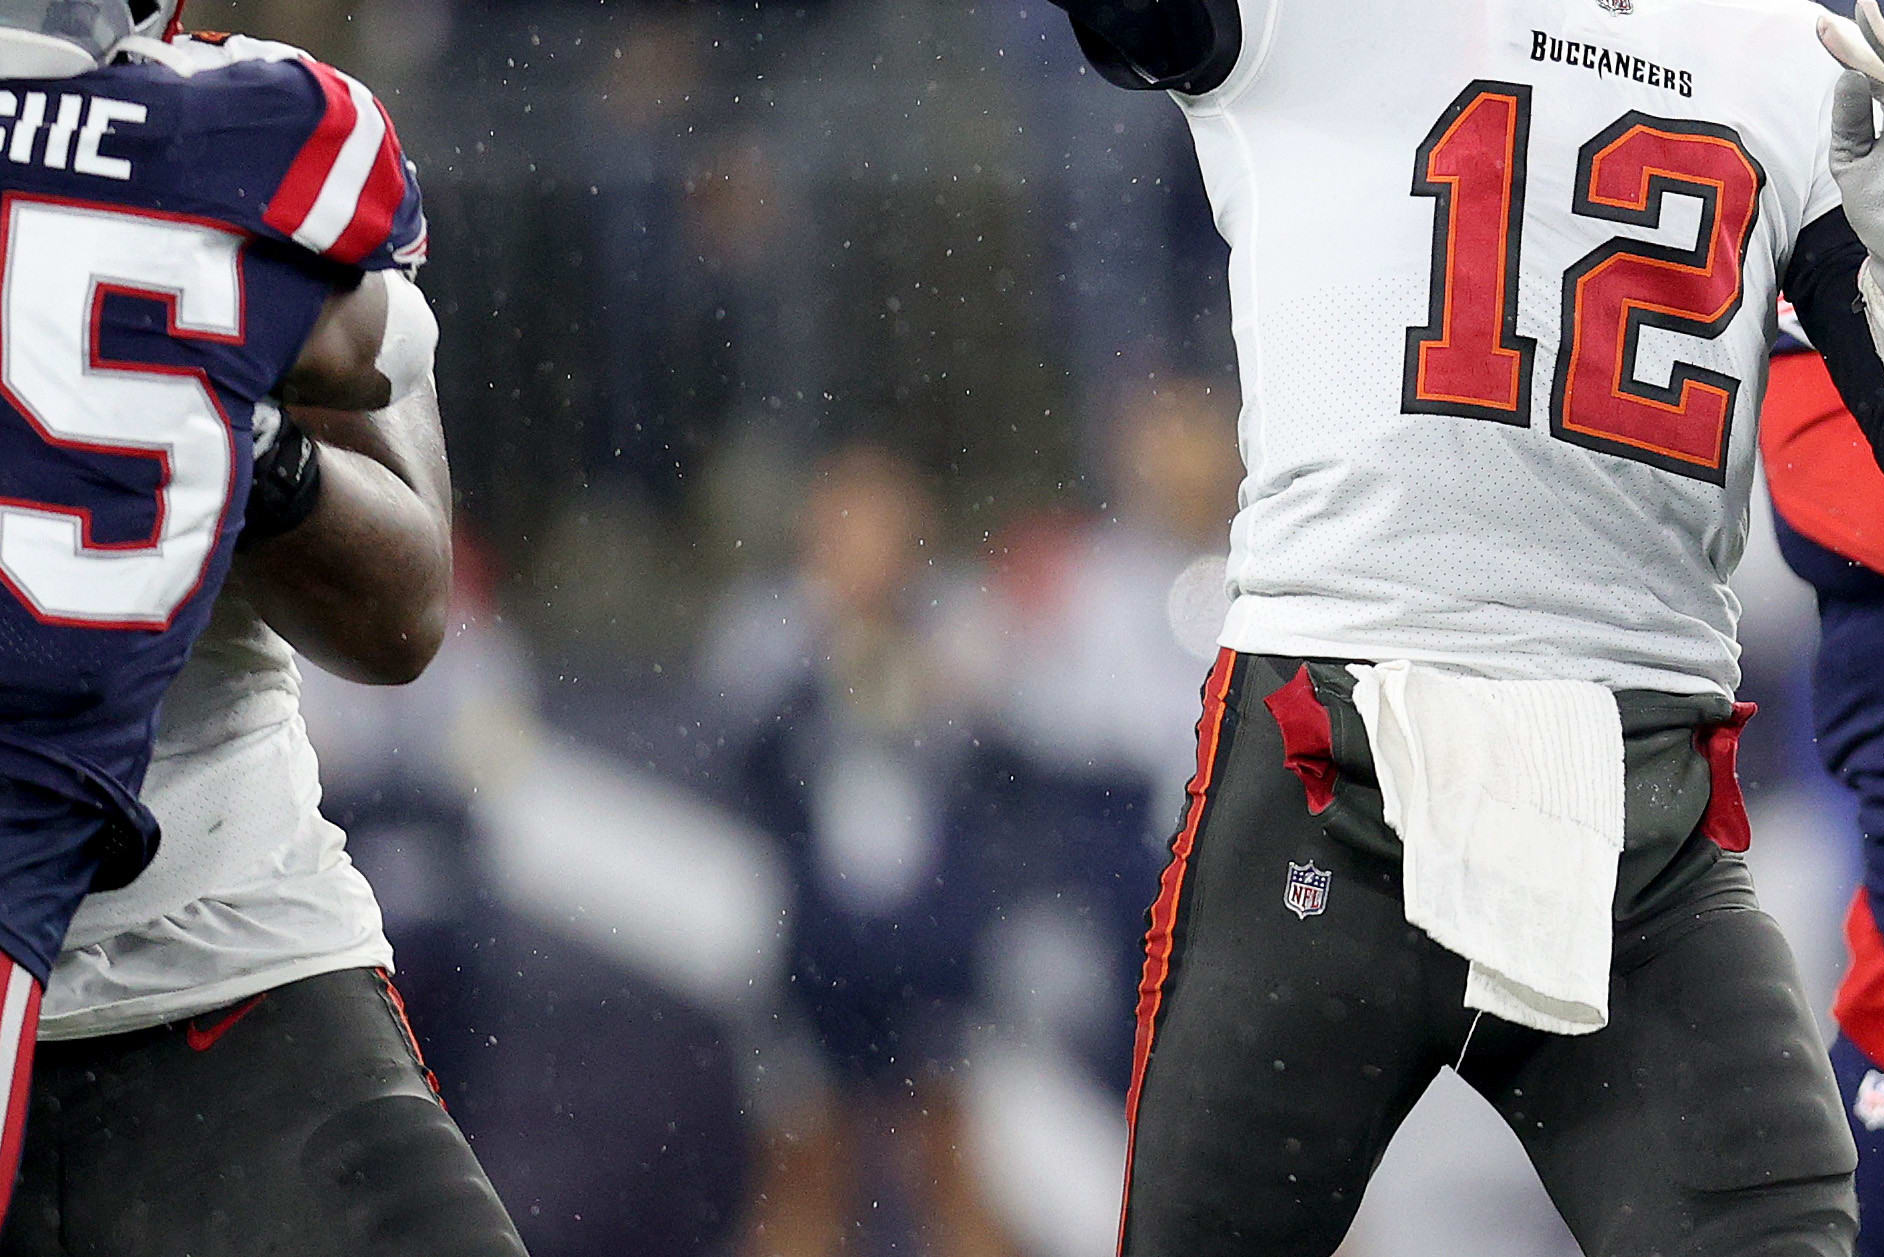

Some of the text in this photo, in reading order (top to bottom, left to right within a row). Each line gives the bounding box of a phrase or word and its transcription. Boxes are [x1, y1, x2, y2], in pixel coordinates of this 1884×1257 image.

[1530, 30, 1693, 98] BUCCANEERS
[0, 90, 148, 181] HE
[1400, 79, 1767, 489] 12
[1291, 884, 1323, 909] NFL
